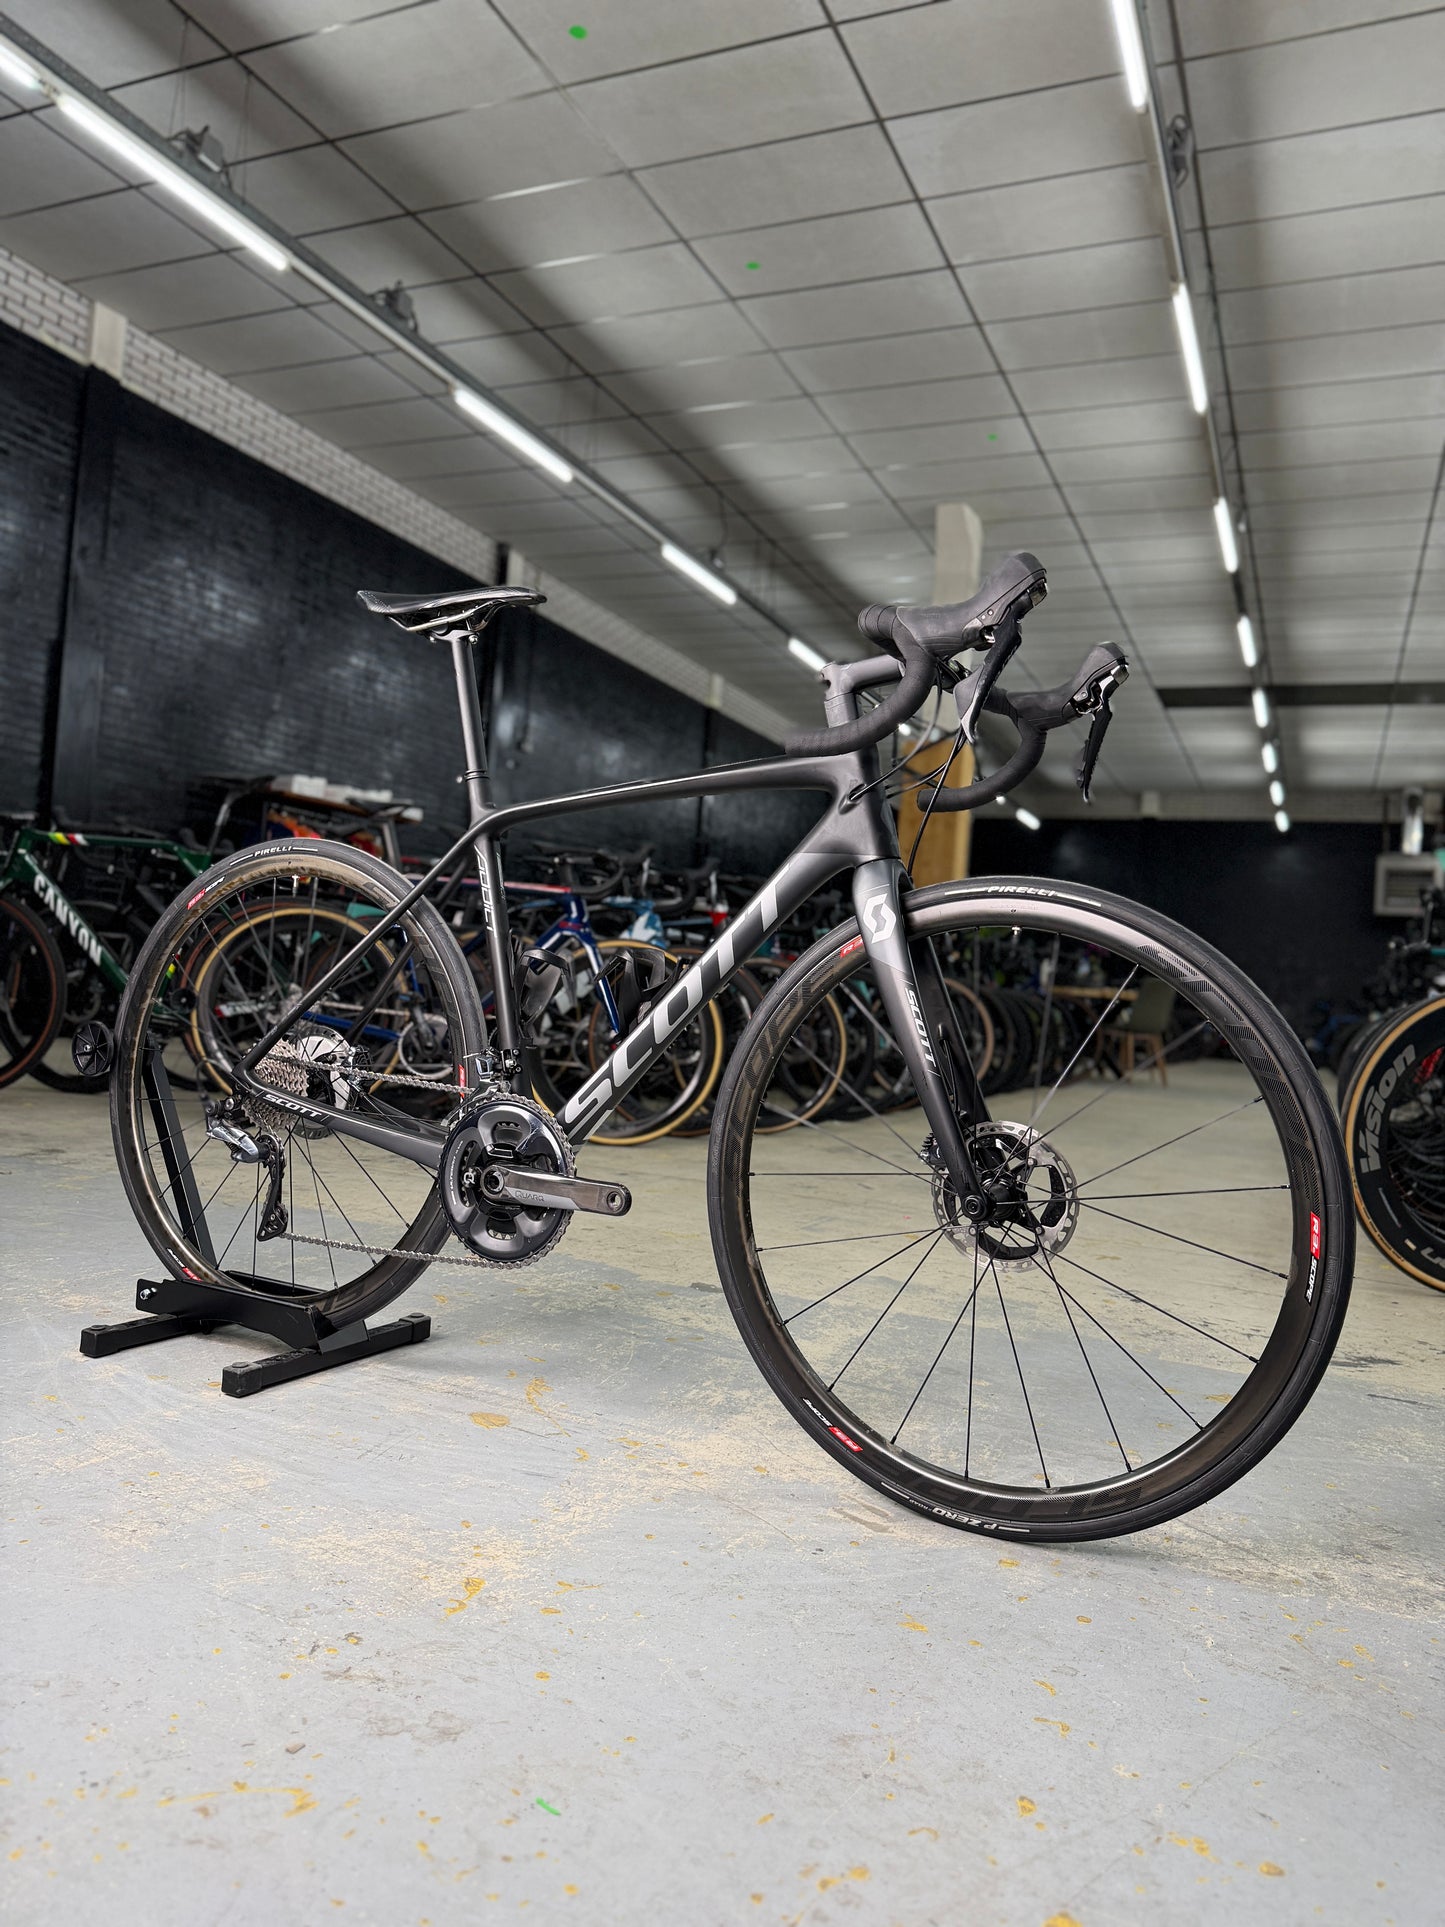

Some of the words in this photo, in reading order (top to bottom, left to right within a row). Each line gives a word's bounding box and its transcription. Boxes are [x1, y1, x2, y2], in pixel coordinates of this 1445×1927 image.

[254, 845, 292, 858] PIRELLI
[473, 844, 498, 939] ADDICT
[987, 885, 1056, 898] PIRELLI
[33, 872, 103, 968] CANYON
[564, 862, 791, 1140] SCOTT
[904, 987, 938, 1068] SCOTT
[262, 1093, 322, 1118] SCOTT
[1358, 1043, 1417, 1175] vision
[514, 1190, 545, 1202] QUARQ
[1305, 1255, 1318, 1303] SCOPE
[931, 1506, 982, 1528] ZERO
[983, 1522, 998, 1531] P
